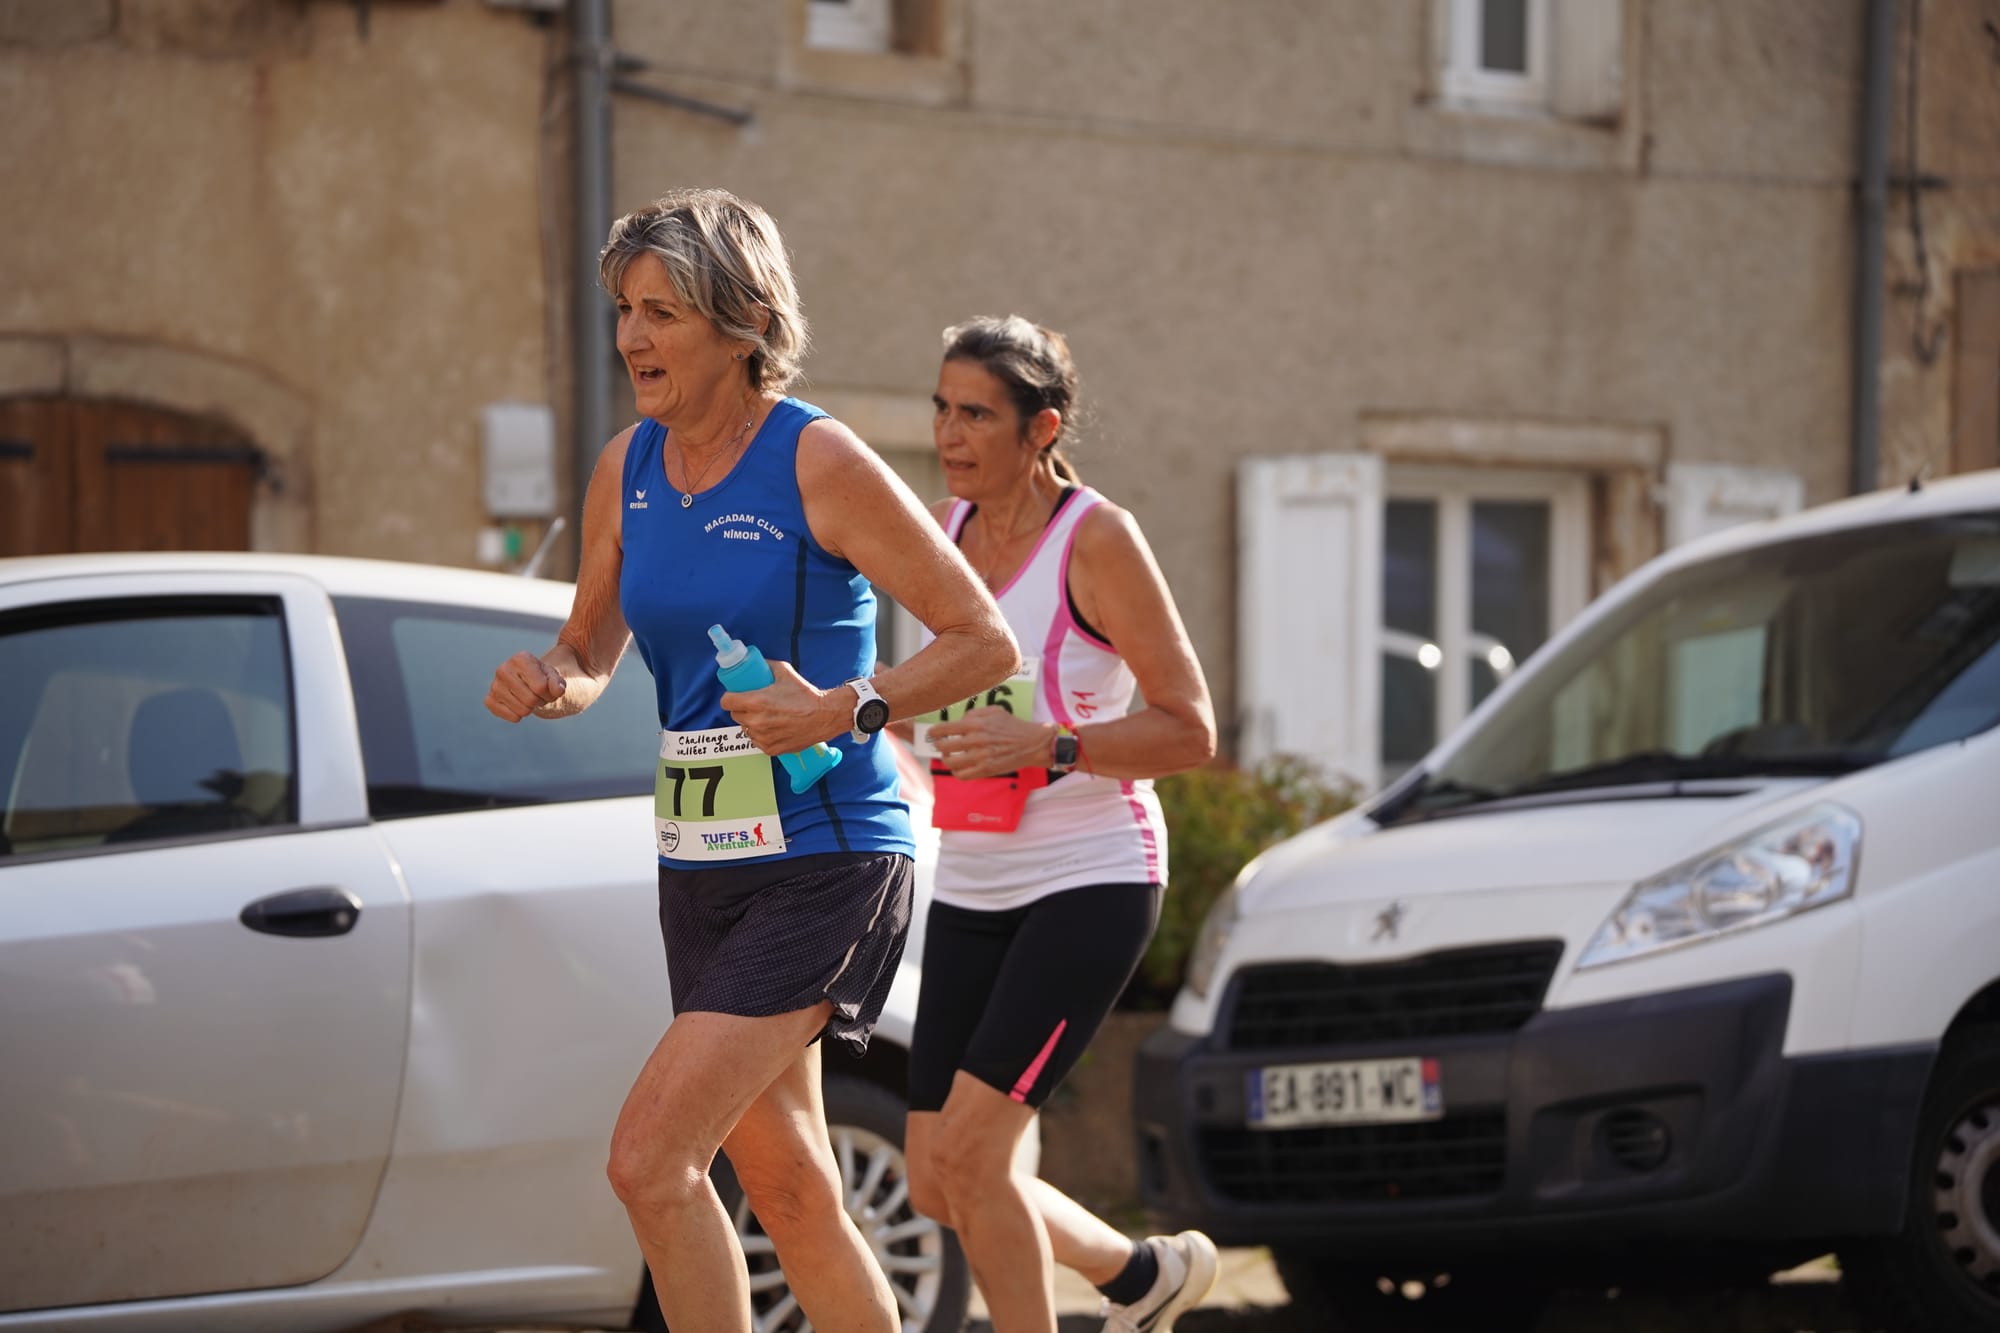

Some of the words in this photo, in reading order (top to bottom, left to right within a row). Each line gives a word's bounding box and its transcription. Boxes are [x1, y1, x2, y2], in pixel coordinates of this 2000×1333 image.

[704, 513, 755, 533] MACADAM
[757, 518, 784, 540] CLUB
[723, 528, 760, 541] NÎMOIS
[679, 734, 729, 745] Challenge
[677, 746, 707, 756] vallées
[665, 765, 724, 817] 77
[701, 831, 749, 844] TUFF'S
[707, 840, 755, 851] Aventure
